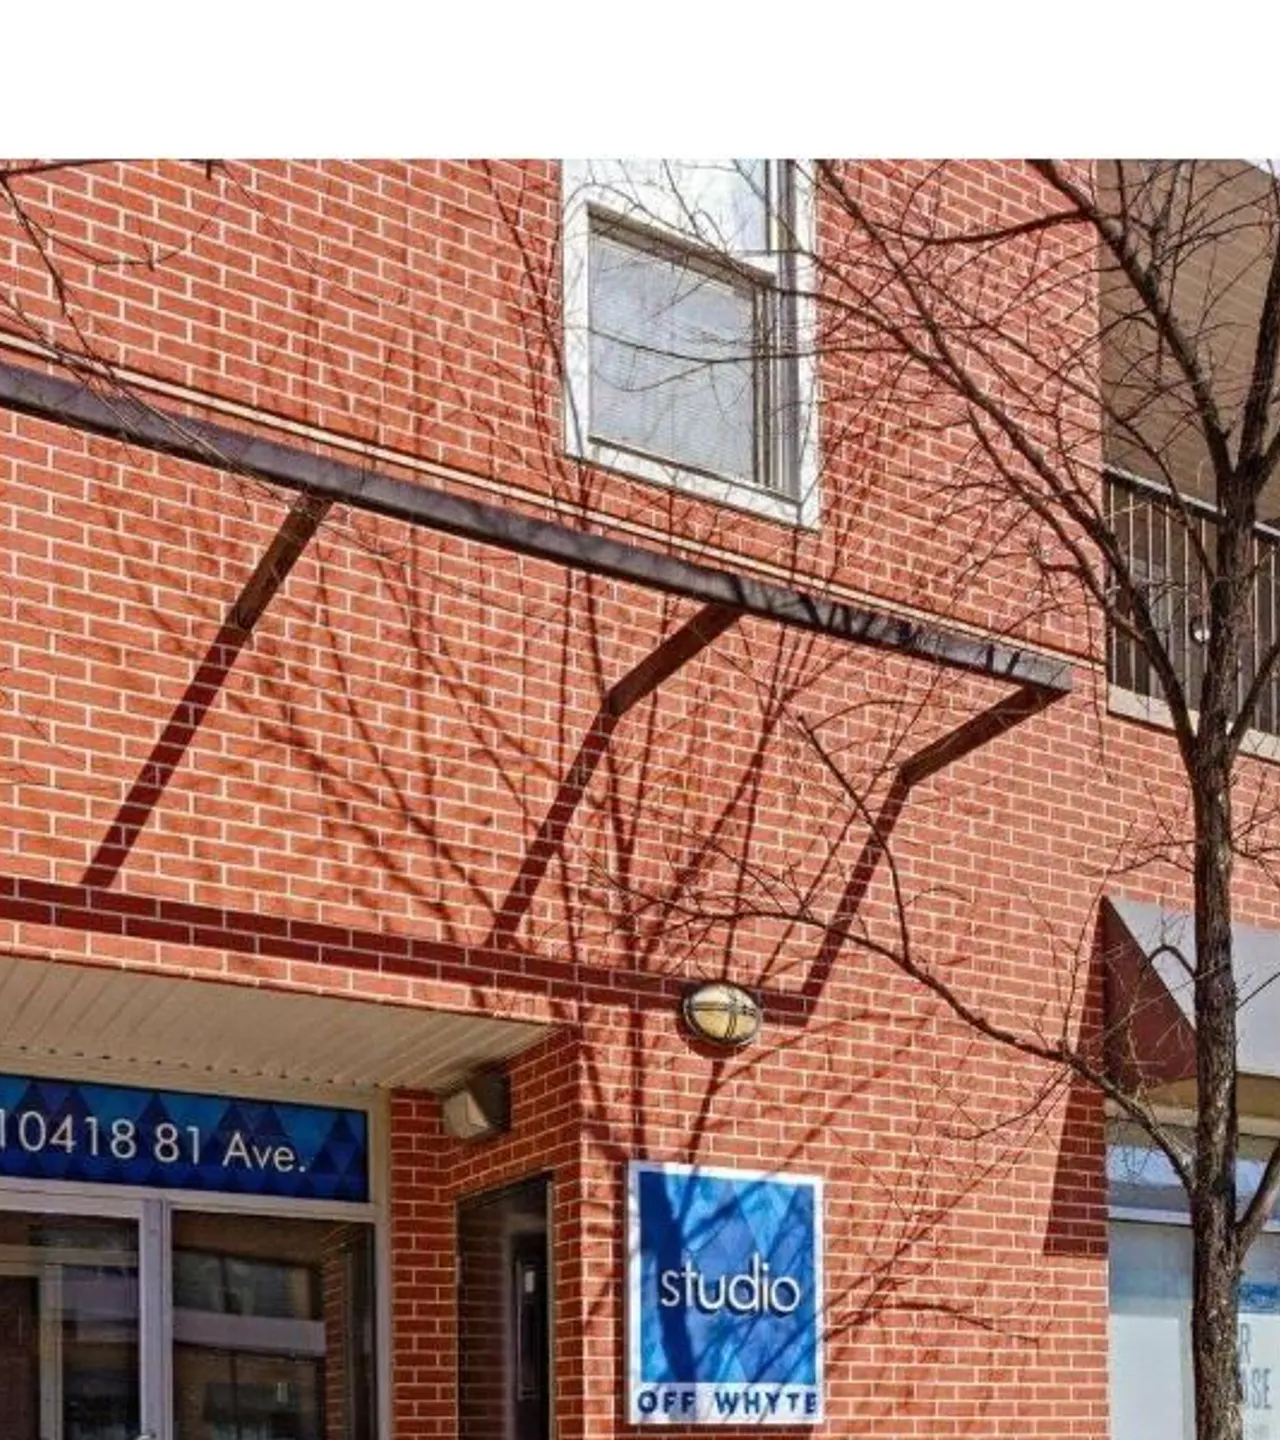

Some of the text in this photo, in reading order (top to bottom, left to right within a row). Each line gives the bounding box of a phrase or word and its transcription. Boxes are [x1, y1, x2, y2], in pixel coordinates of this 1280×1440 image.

[153, 1121, 201, 1165] 81
[221, 1131, 308, 1174] Ave.
[660, 1252, 801, 1313] studio
[637, 1390, 817, 1416] OFF WHYTE
